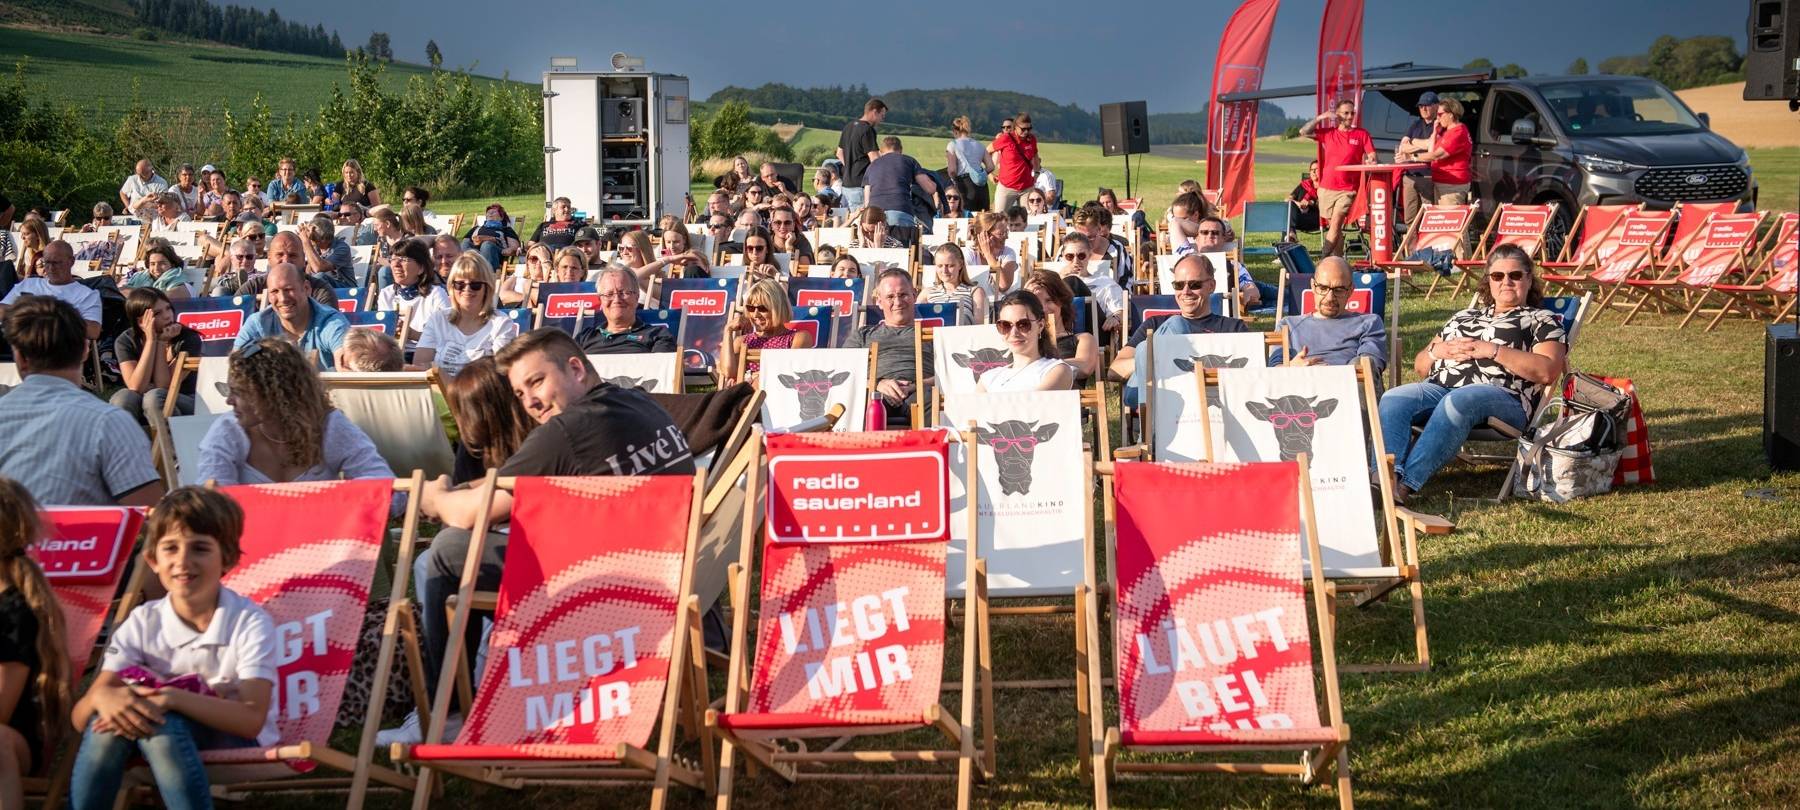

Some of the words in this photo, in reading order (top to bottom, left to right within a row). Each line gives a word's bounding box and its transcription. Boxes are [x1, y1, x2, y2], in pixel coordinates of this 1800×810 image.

[1372, 188, 1386, 251] radio
[188, 318, 231, 330] radio
[557, 299, 593, 309] radio
[681, 297, 717, 306] radio
[605, 429, 673, 476] Livé
[792, 473, 860, 490] radio
[792, 490, 921, 511] sauerland
[779, 585, 911, 656] LIEGT
[1135, 606, 1290, 676] LÄUFT
[508, 625, 641, 689] LIEGT
[804, 644, 913, 701] MIR
[525, 680, 632, 732] MIR
[1175, 669, 1269, 719] BEI
